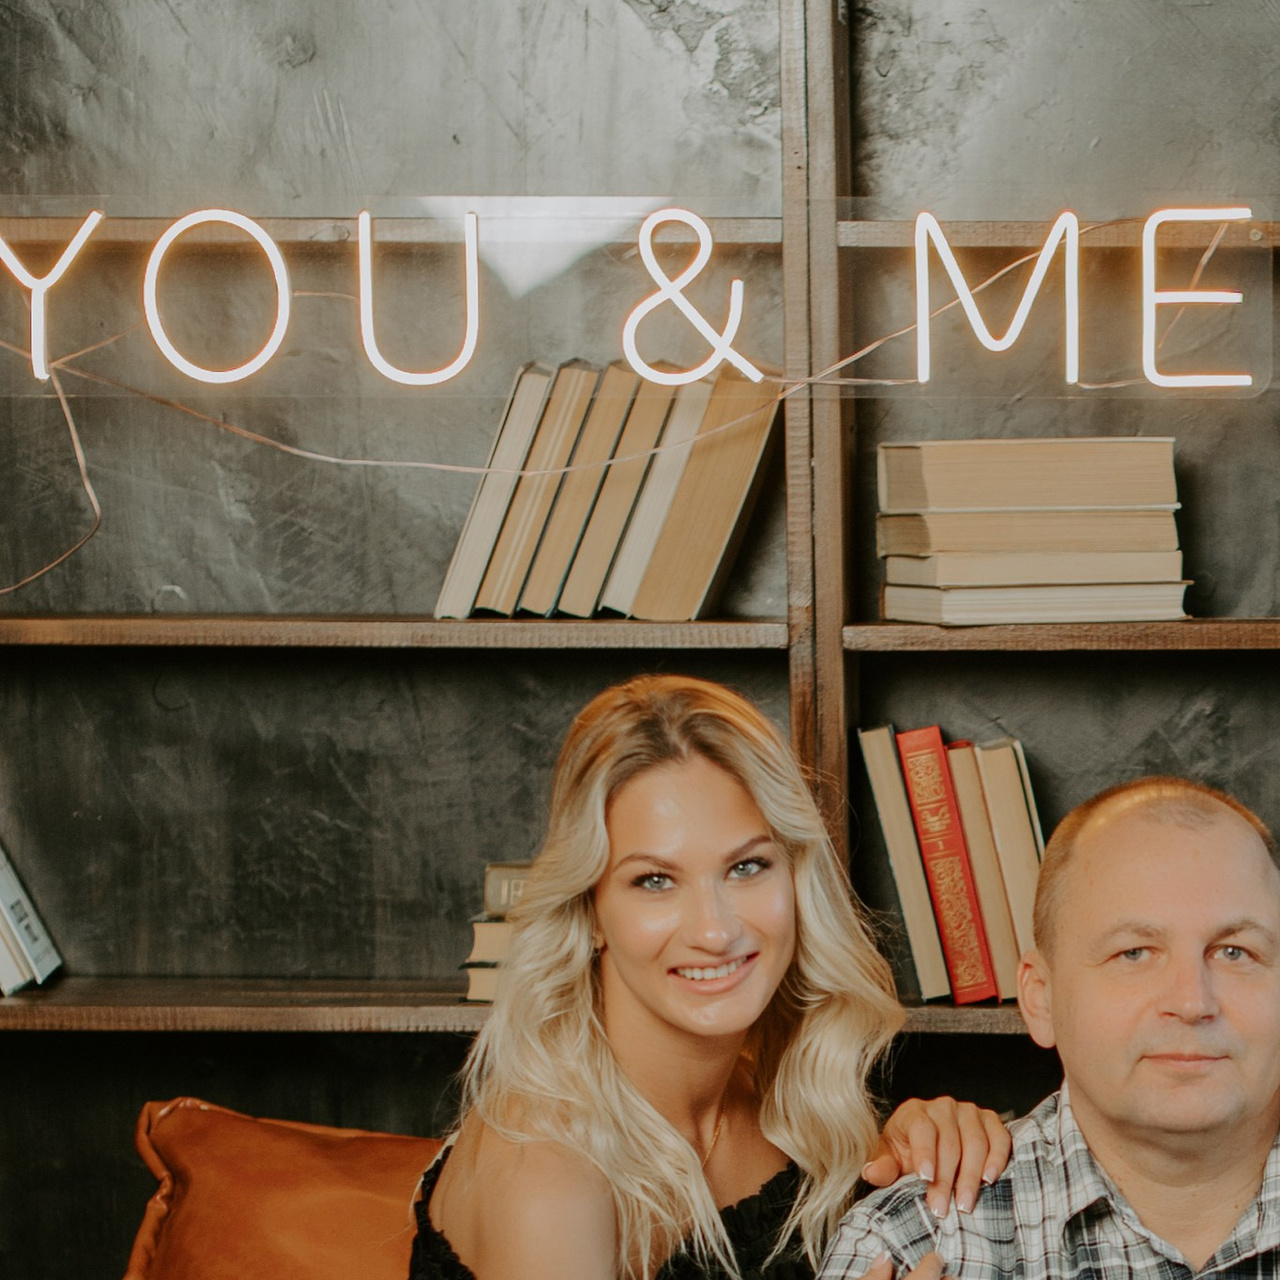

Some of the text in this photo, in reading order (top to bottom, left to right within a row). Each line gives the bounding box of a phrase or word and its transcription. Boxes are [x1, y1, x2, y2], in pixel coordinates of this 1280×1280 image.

[0, 208, 1252, 387] YOU & ME
